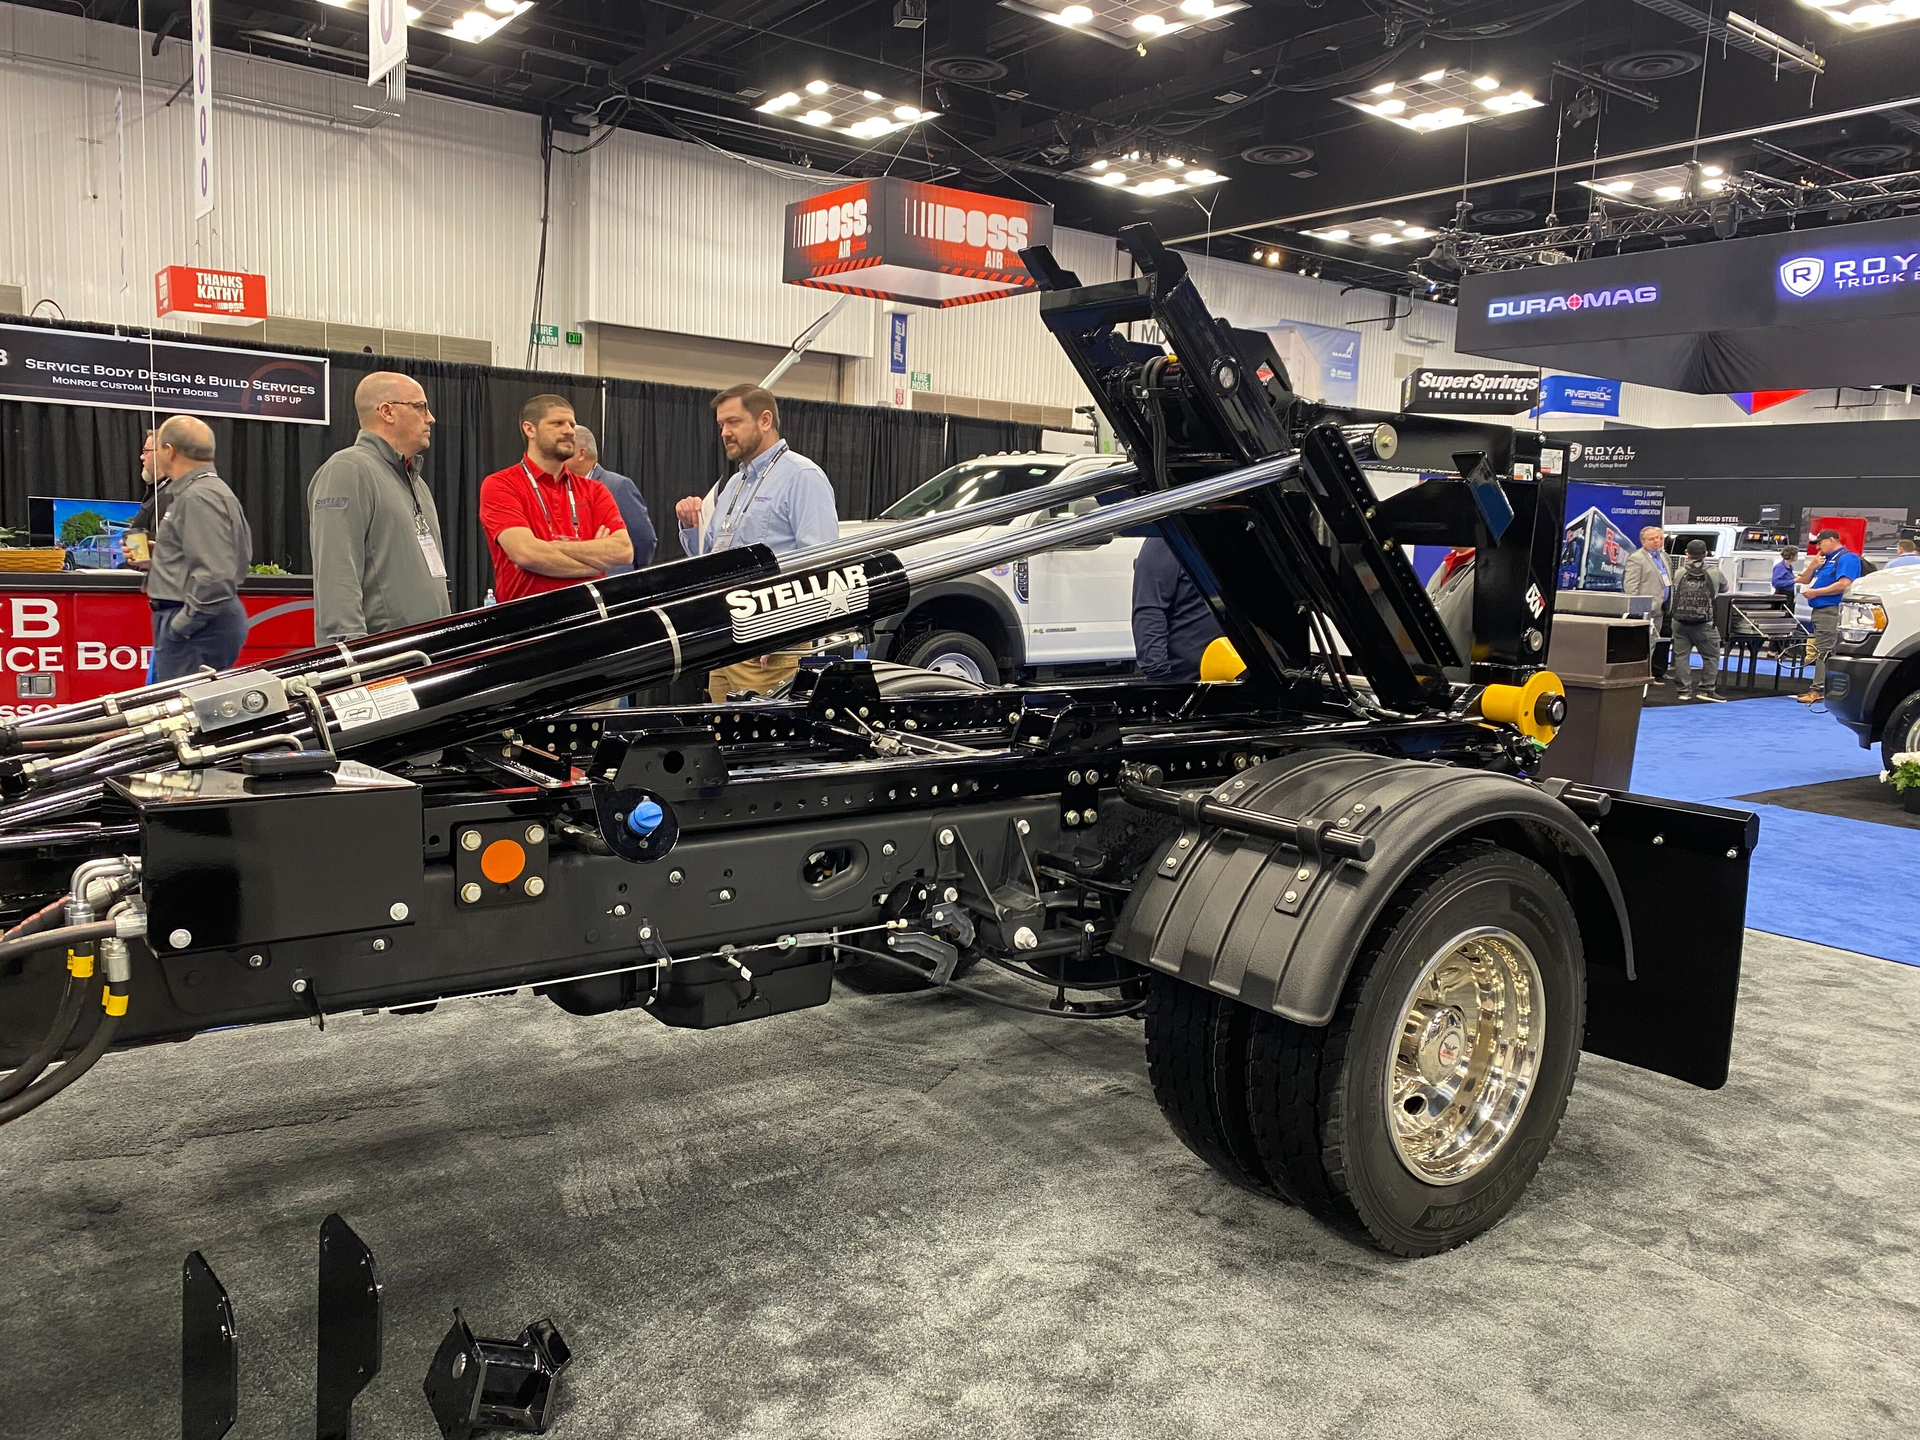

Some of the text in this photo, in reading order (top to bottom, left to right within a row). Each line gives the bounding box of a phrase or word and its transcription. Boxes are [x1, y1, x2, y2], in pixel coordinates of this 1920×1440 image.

[814, 198, 869, 243] BOSS
[943, 205, 1029, 253] BOSS
[838, 241, 851, 259] AIR
[985, 250, 1004, 270] AIR
[1834, 253, 1920, 279] ROY
[195, 272, 244, 289] THANKS
[1834, 272, 1906, 290] TRUCK
[196, 284, 245, 302] KATHY!
[25, 357, 316, 395] SERVICE BODY DESIGN & BUILD SERVICES
[912, 380, 930, 390] HOSE
[913, 372, 928, 382] FIRE
[1418, 371, 1540, 393] SuperSprings
[52, 375, 219, 398] MONROE CUSTOM UTILITY BODIES
[264, 394, 288, 404] STEP
[288, 396, 302, 405] UP
[1428, 391, 1529, 401] INTERNATIONAL
[1584, 446, 1636, 456] ROYAL
[1696, 515, 1721, 523] RUGGED
[725, 563, 869, 620] STELLAR
